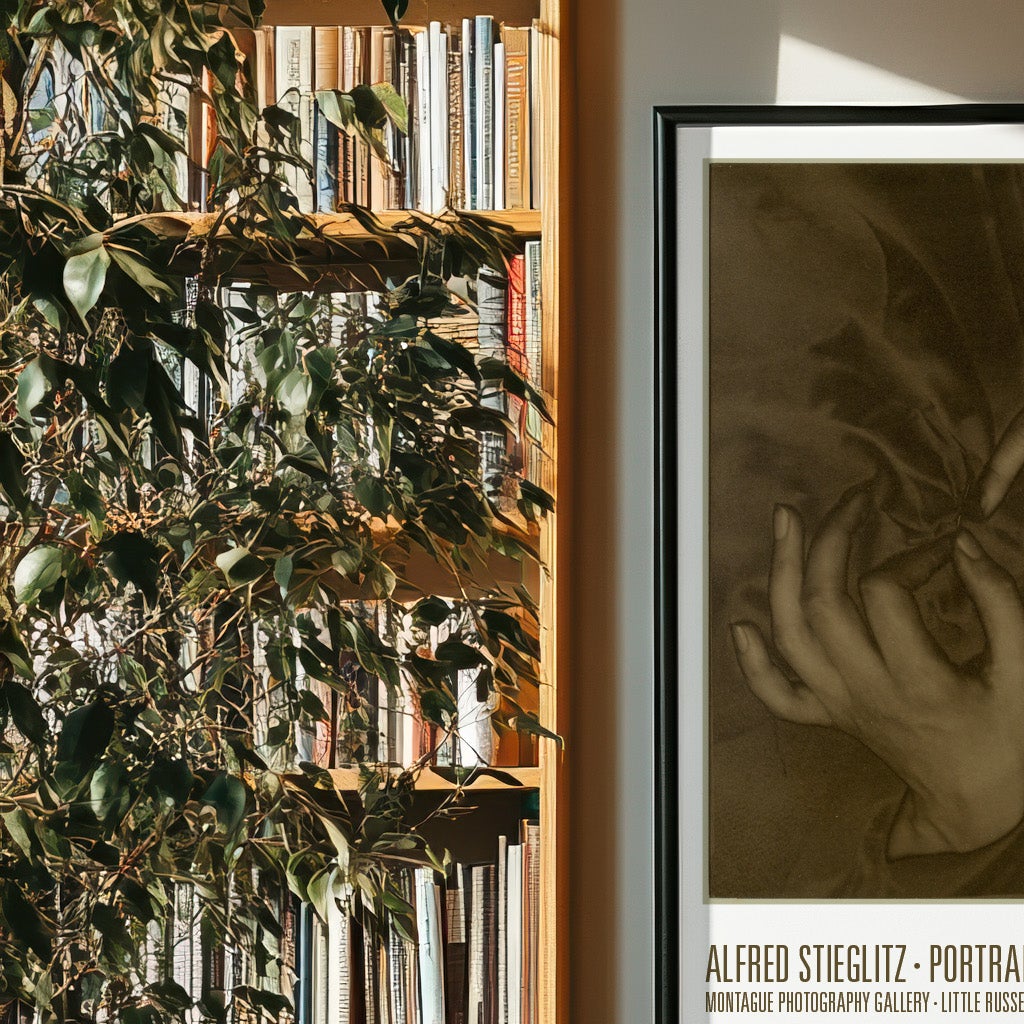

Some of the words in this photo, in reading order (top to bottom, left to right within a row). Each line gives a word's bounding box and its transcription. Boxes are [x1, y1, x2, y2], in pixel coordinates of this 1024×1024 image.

[705, 944, 789, 983] ALFRED
[799, 944, 907, 983] STIEGLITZ
[705, 991, 774, 1013] MONTAGUE
[778, 991, 870, 1013] PHOTOGRAPHY
[874, 991, 930, 1013] GALLERY
[941, 991, 981, 1013] LITTLE
